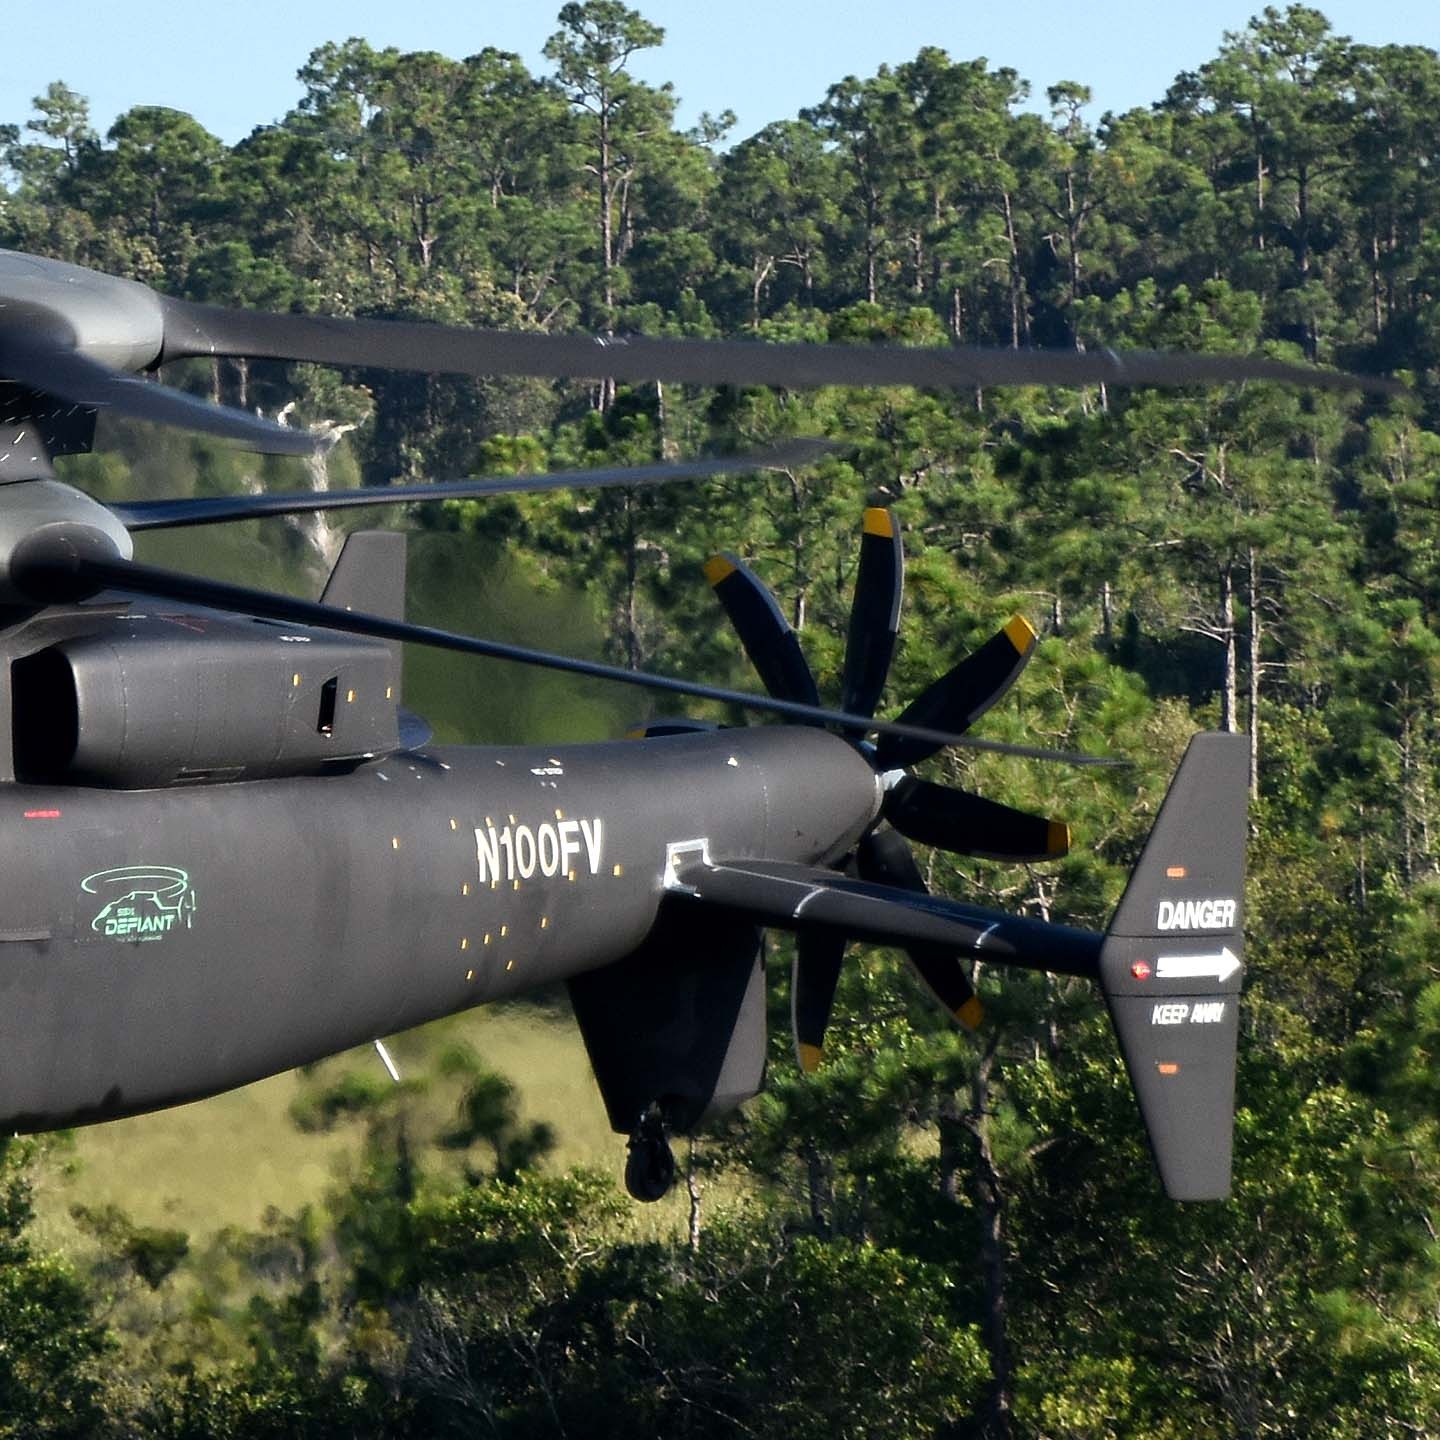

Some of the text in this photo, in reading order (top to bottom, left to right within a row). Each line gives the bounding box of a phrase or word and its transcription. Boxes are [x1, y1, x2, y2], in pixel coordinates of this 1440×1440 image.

[474, 818, 602, 883] N100FV
[104, 914, 175, 935] DEFIANT
[1157, 899, 1236, 930] DANGER
[1151, 1002, 1225, 1025] KEEP AWAY
